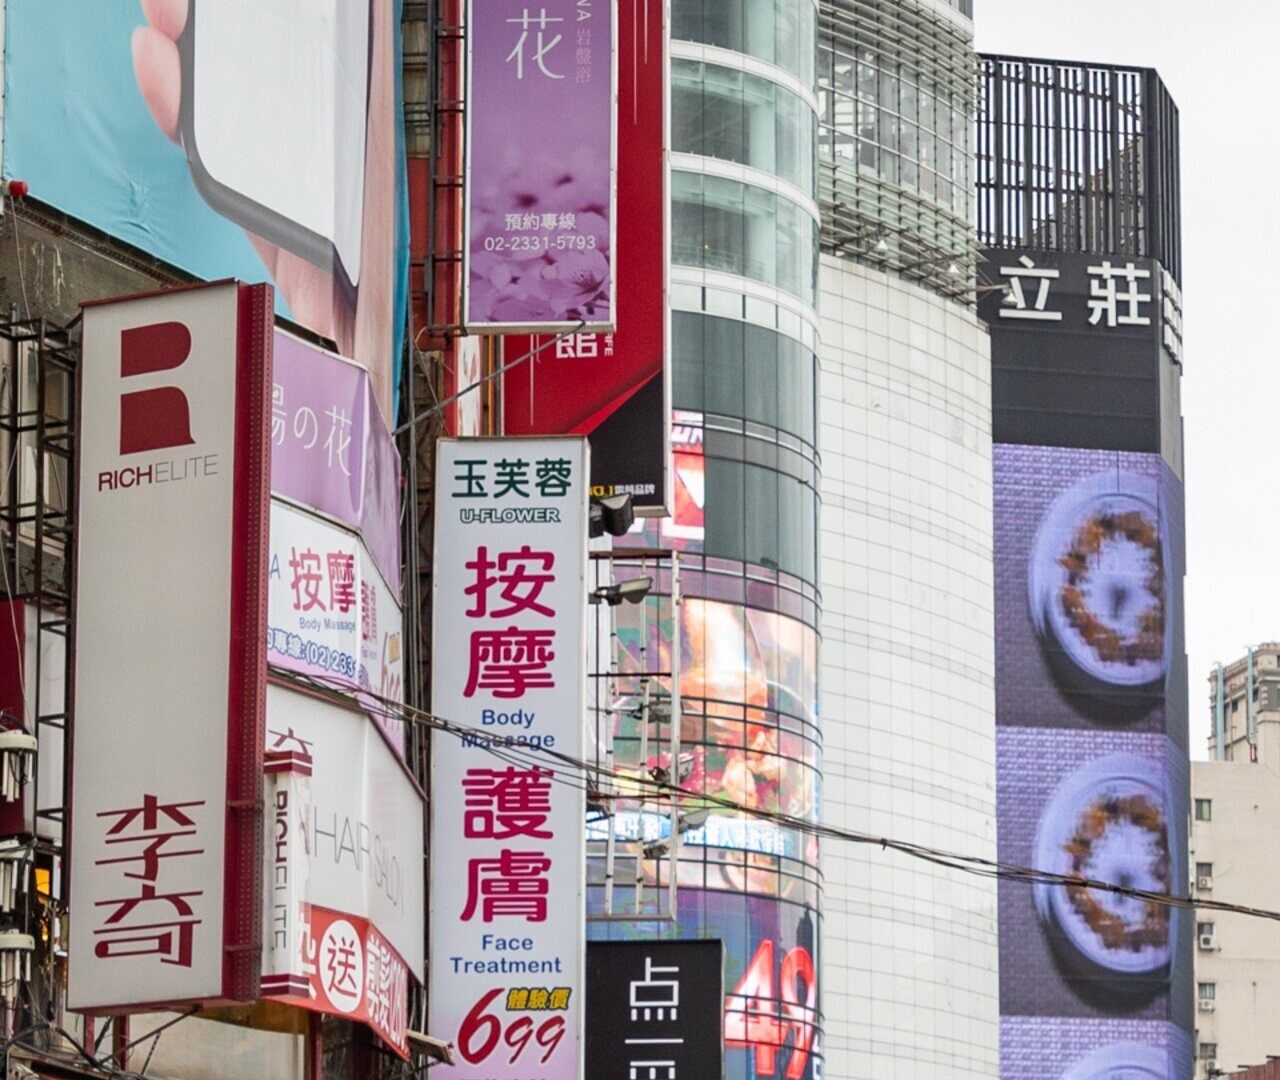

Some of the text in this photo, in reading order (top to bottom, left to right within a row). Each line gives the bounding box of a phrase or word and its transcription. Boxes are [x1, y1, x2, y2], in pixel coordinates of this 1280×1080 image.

[505, 9, 566, 79] 花
[504, 212, 577, 231] 預約專線
[484, 235, 596, 252] 02-2331-5793
[98, 454, 218, 492] RICHELITE
[452, 458, 572, 499] 玉芙蓉
[460, 507, 560, 524] U-FLOWER
[289, 545, 355, 614] 按摩
[299, 617, 321, 631] Body
[463, 545, 556, 699] 按摩
[481, 709, 535, 730] Body
[461, 732, 555, 751] Massage
[314, 806, 370, 878] HAIR
[460, 766, 555, 923] 護膚
[94, 793, 206, 967] 李奇
[482, 935, 534, 953] Face
[327, 932, 357, 1000] 送
[450, 956, 562, 975] Treatment
[457, 988, 567, 1065] 699
